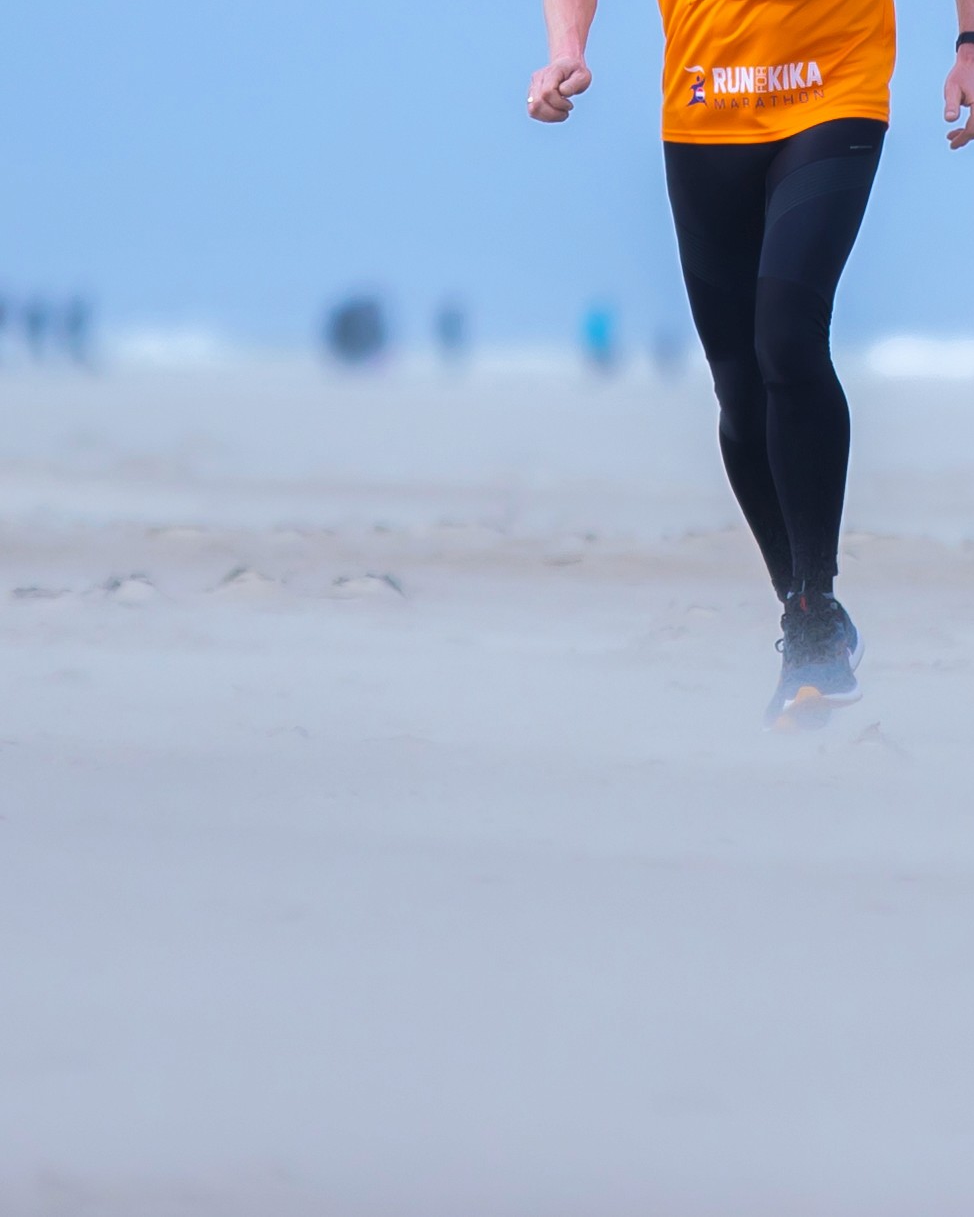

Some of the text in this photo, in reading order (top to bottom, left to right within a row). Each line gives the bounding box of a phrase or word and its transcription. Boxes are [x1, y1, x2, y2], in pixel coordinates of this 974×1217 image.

[712, 66, 754, 93] RUN
[768, 61, 823, 92] KIKA
[714, 89, 825, 110] MARATHON
